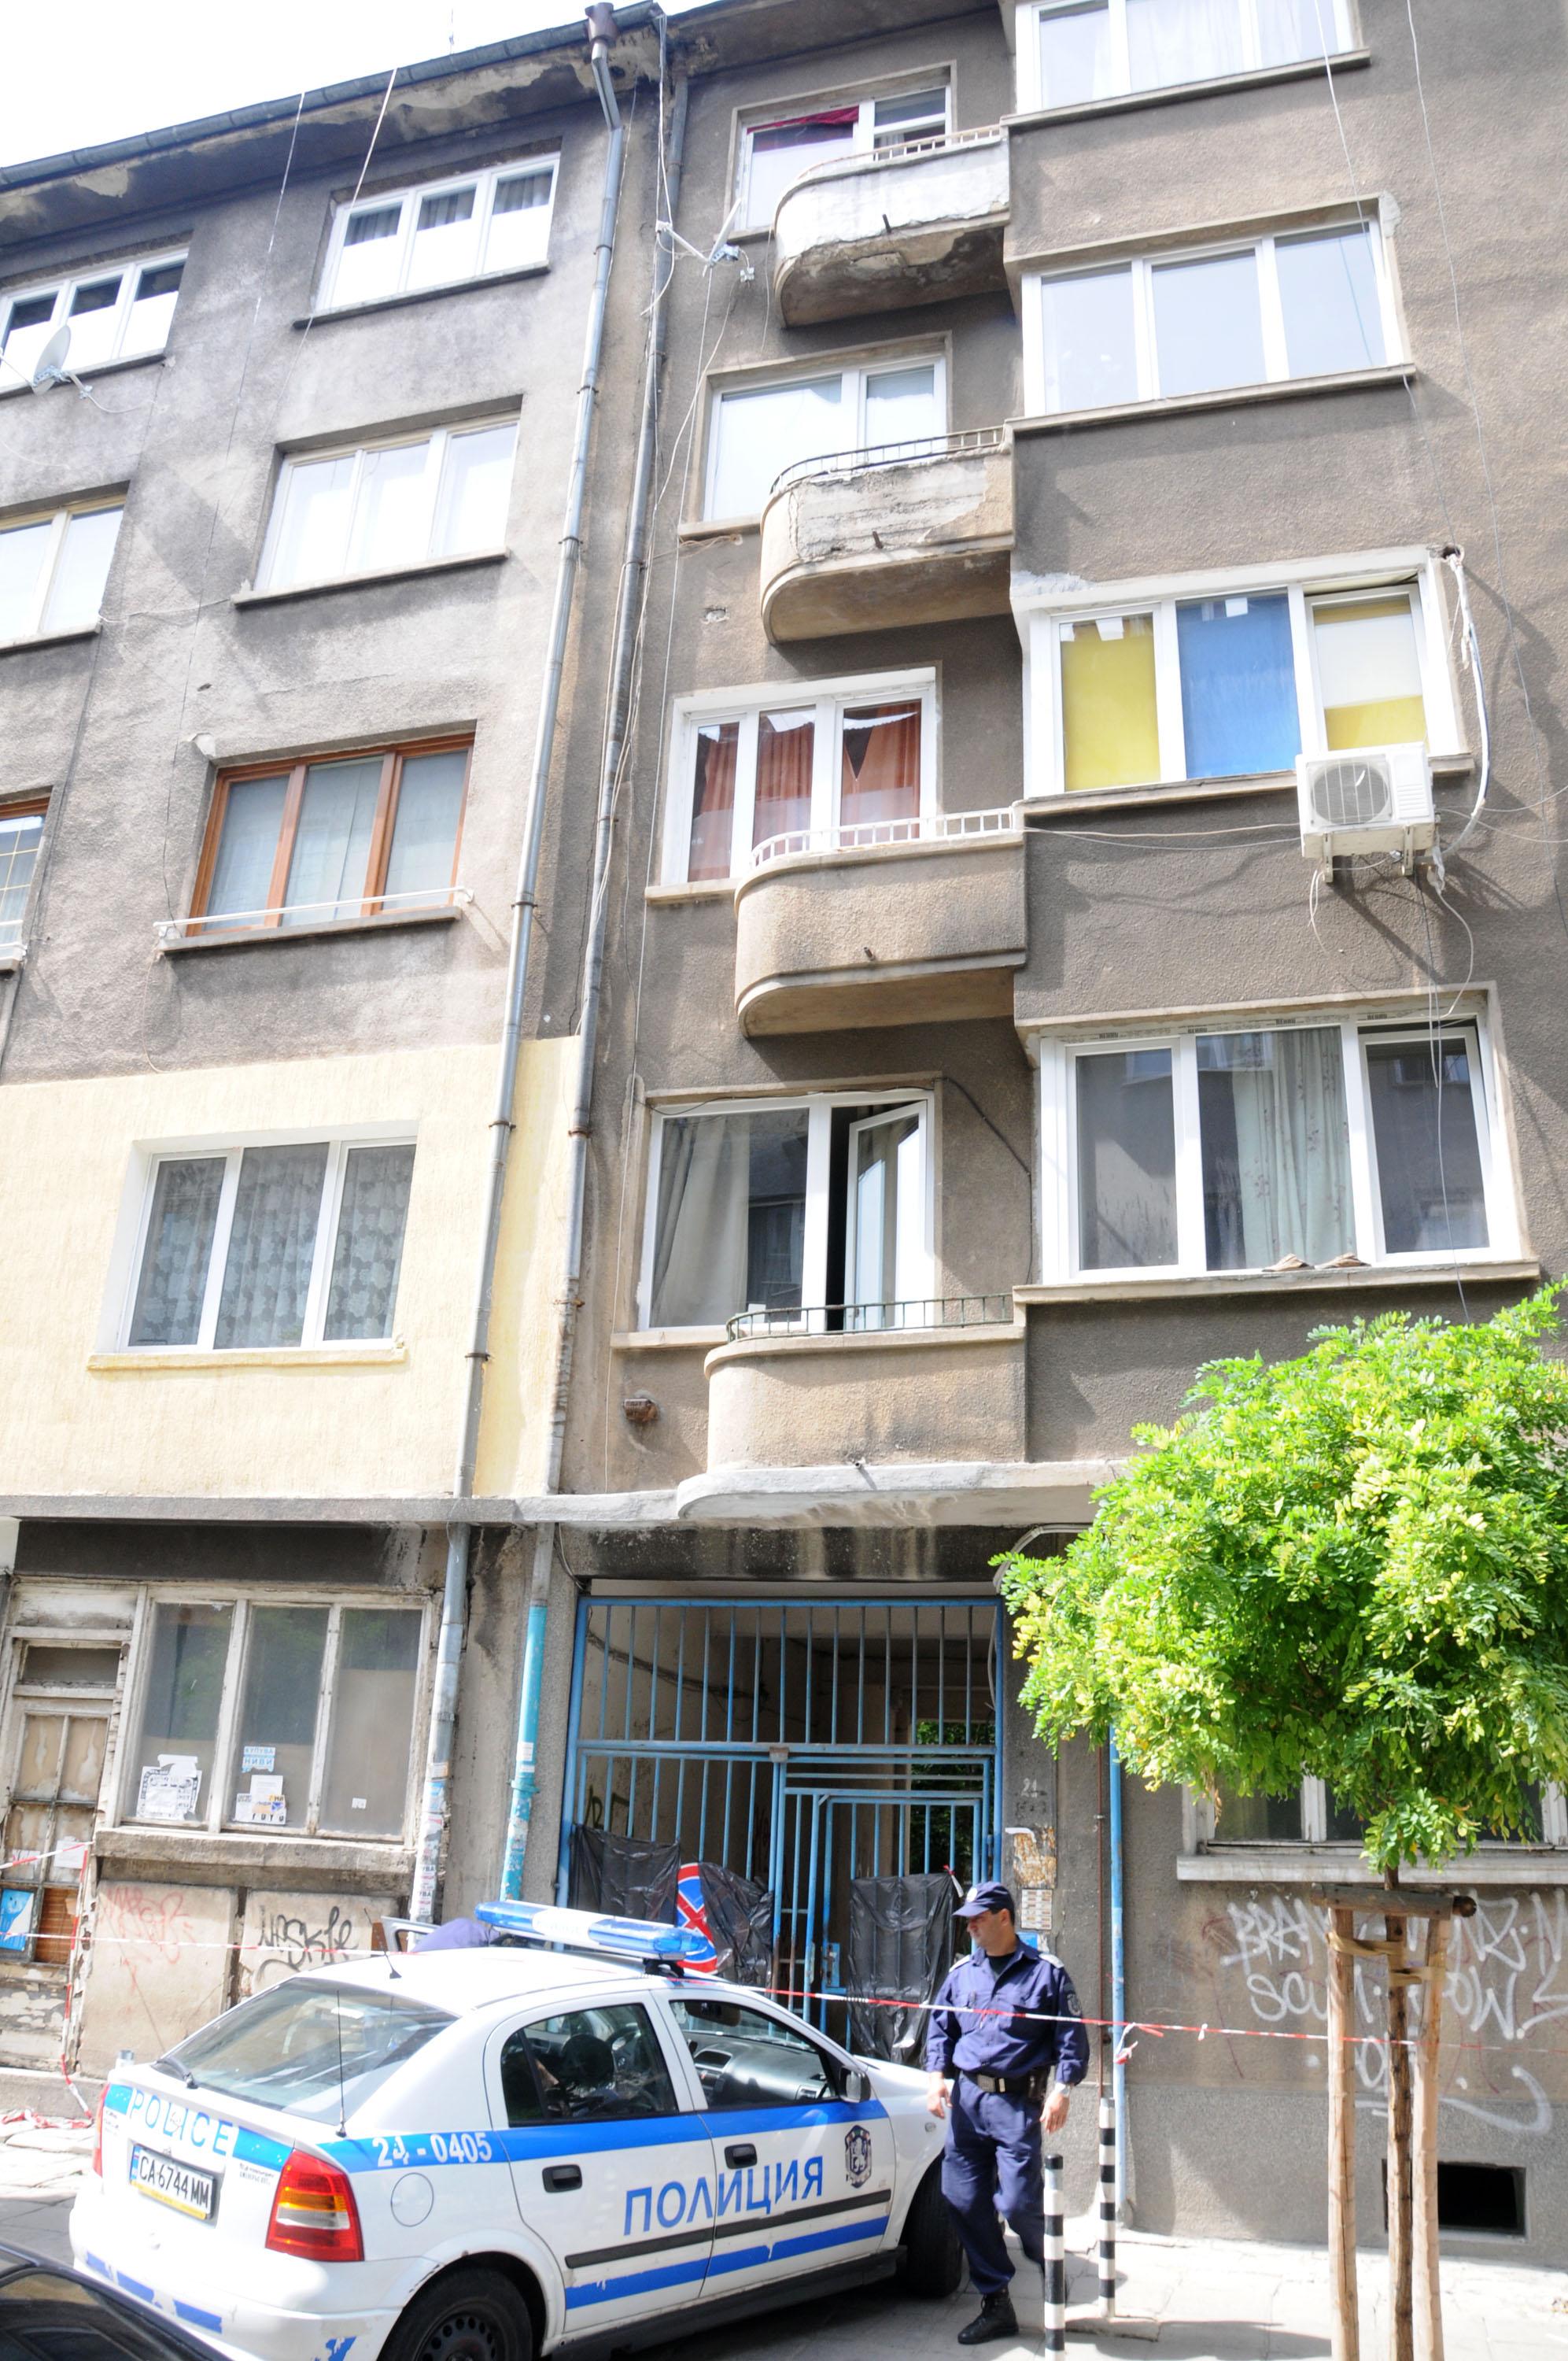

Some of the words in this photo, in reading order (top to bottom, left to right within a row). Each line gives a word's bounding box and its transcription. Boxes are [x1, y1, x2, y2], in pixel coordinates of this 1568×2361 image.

[129, 2089, 234, 2156] POLICE
[430, 2131, 492, 2163] 0405
[623, 2156, 824, 2236] ПОЛИЦИЯ
